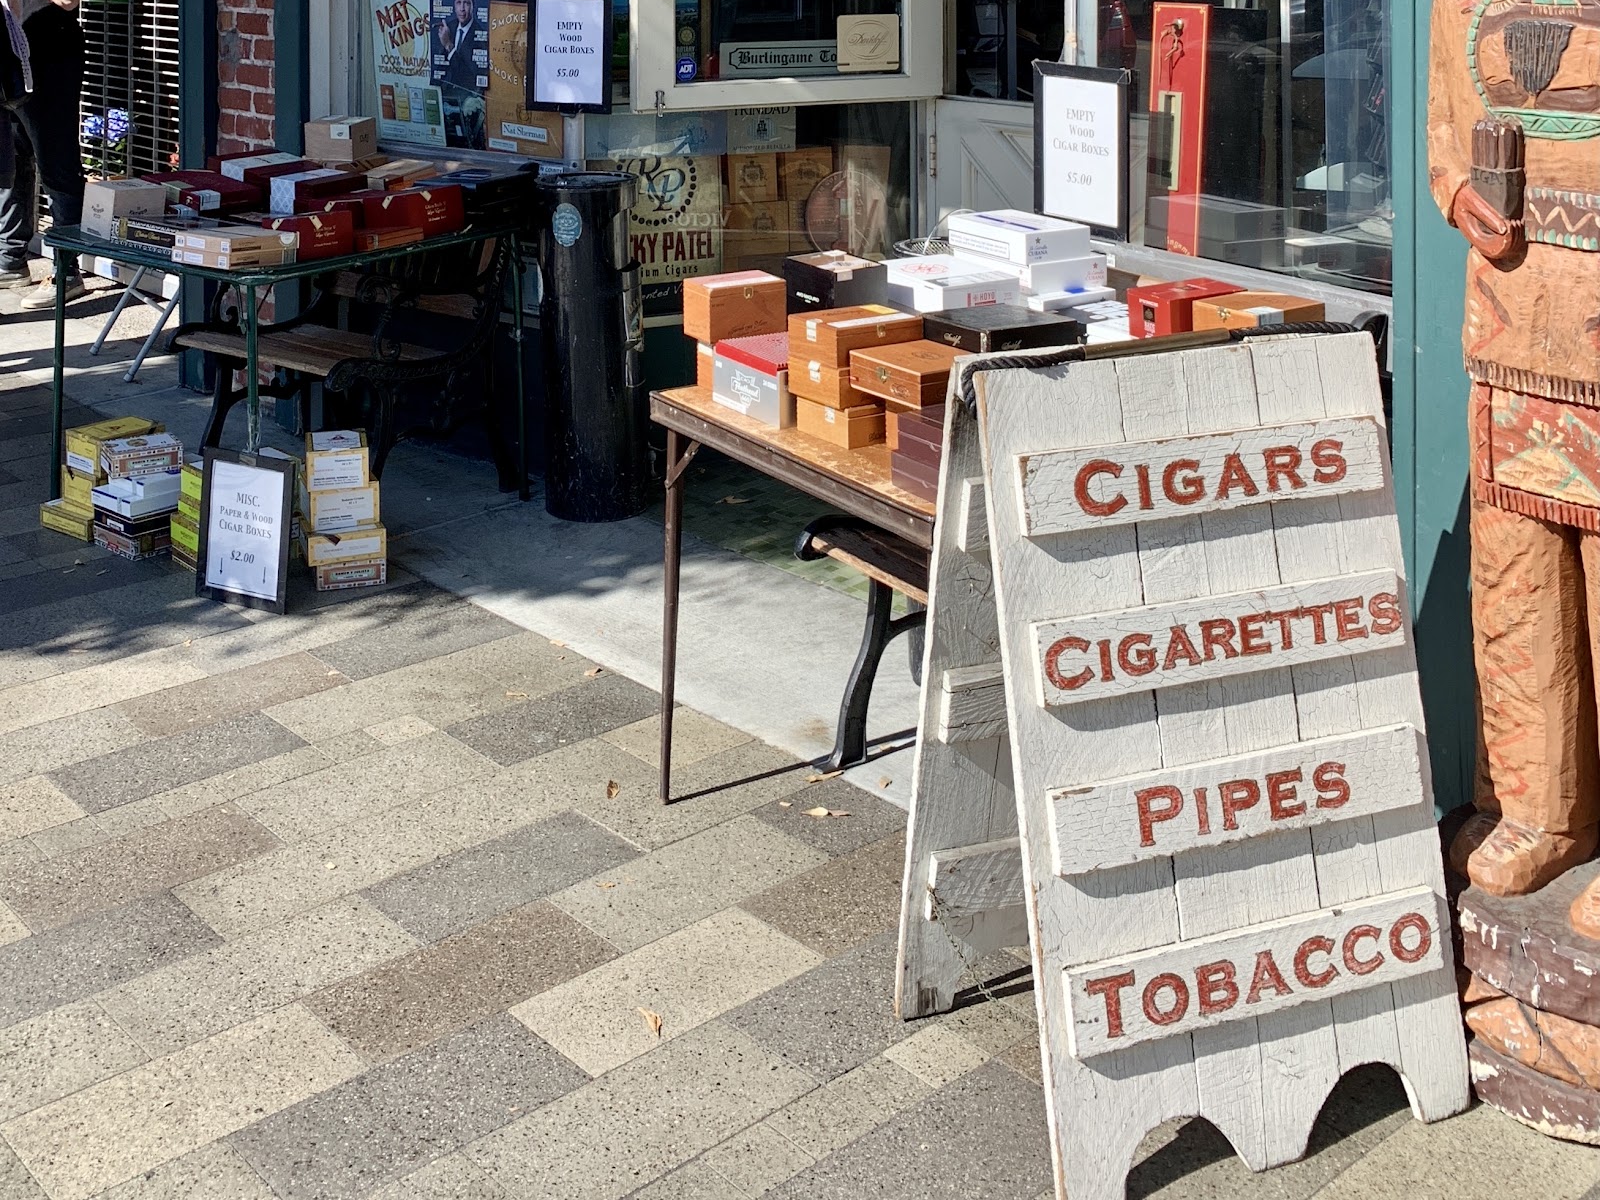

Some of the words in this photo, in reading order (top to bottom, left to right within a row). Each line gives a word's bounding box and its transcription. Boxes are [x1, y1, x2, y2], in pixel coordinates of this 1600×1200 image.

[375, 0, 412, 33] NAT
[388, 13, 431, 49] KINGS
[557, 21, 584, 31] EMPTY
[380, 54, 401, 65] 100%
[402, 56, 431, 68] NATURA
[737, 50, 814, 66] Burlingame
[556, 68, 580, 78] $5.00
[678, 64, 694, 74] ADT
[1065, 108, 1096, 123] EMPTY
[503, 124, 516, 136] Nat
[517, 126, 546, 140] Sherman
[1065, 171, 1093, 186] $5.00
[662, 228, 715, 263] PATEL
[664, 264, 699, 277] Cigars
[980, 291, 995, 301] HOYO
[1074, 439, 1347, 517] CIGARS
[235, 492, 261, 508] MISC.
[243, 510, 250, 520] &
[229, 549, 255, 564] $2.00
[1043, 591, 1403, 693] CIGARETTES
[1133, 761, 1352, 848] PIPES
[1086, 912, 1433, 1039] TOBACCO
